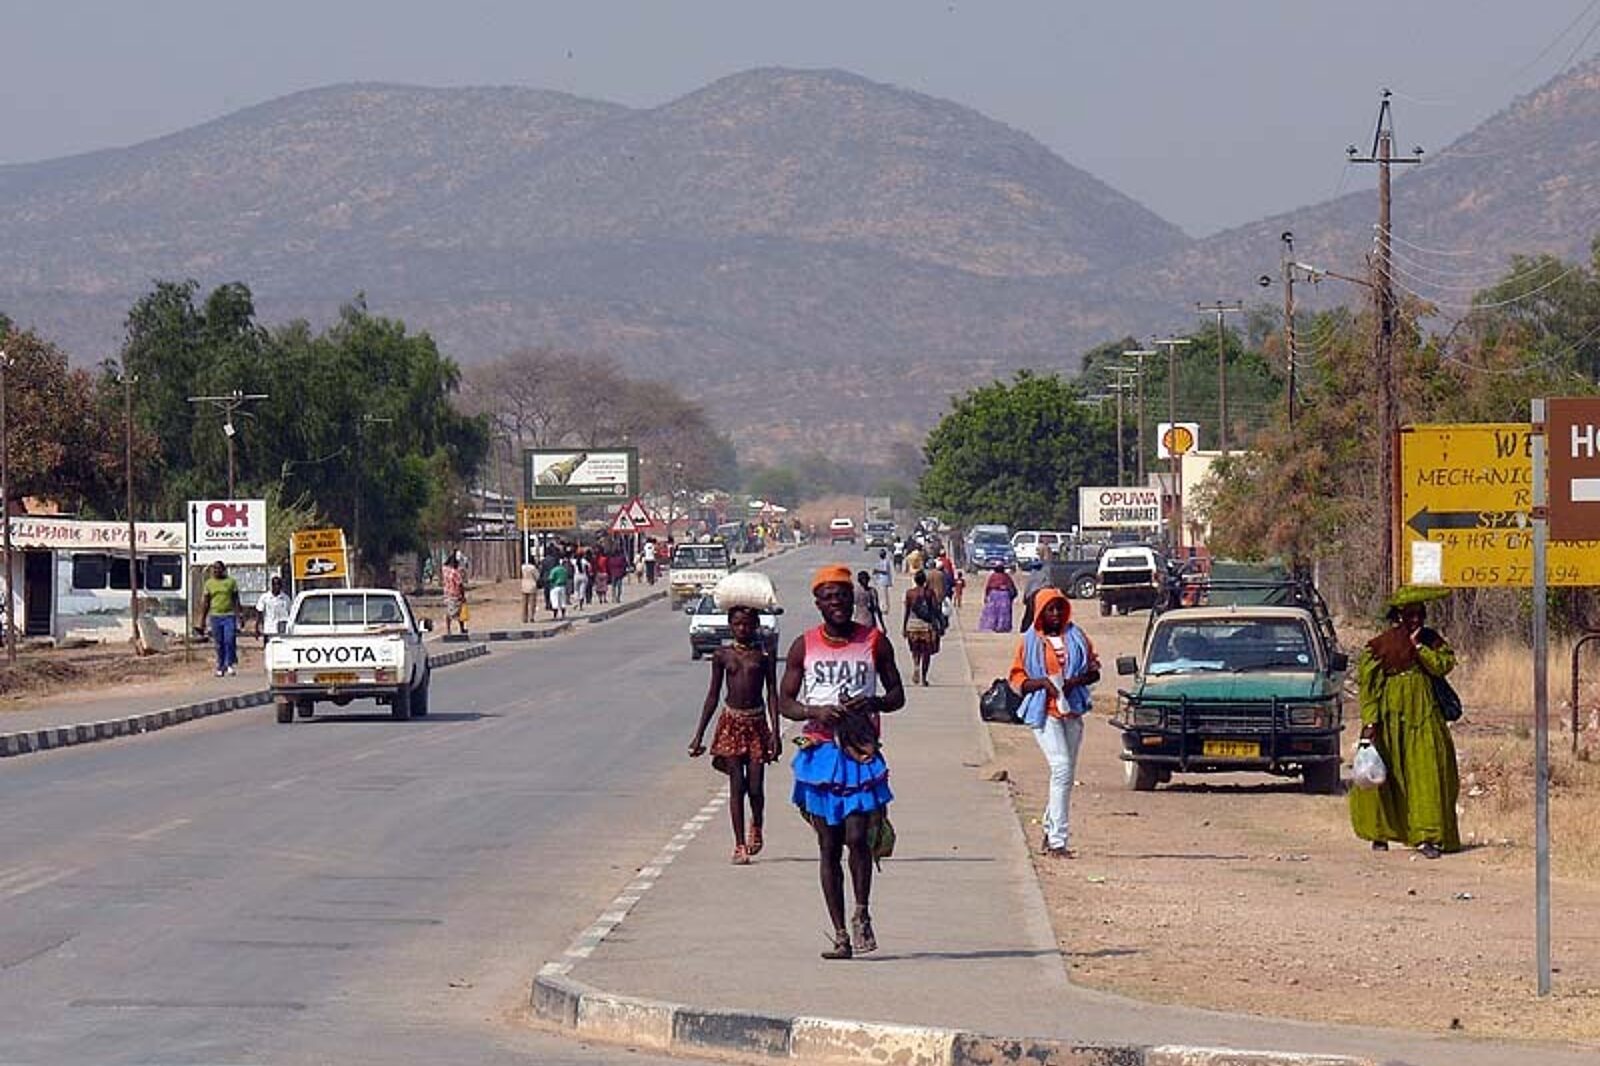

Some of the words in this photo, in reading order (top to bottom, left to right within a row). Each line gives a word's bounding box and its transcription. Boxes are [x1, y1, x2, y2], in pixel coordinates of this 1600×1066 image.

[1571, 424, 1600, 458] H
[1099, 492, 1159, 506] OPUWA
[206, 503, 248, 528] OK
[1099, 507, 1159, 522] SUPERMARKET
[1461, 565, 1500, 582] 065
[292, 646, 377, 664] TOYOTA
[813, 660, 869, 686] STAR
